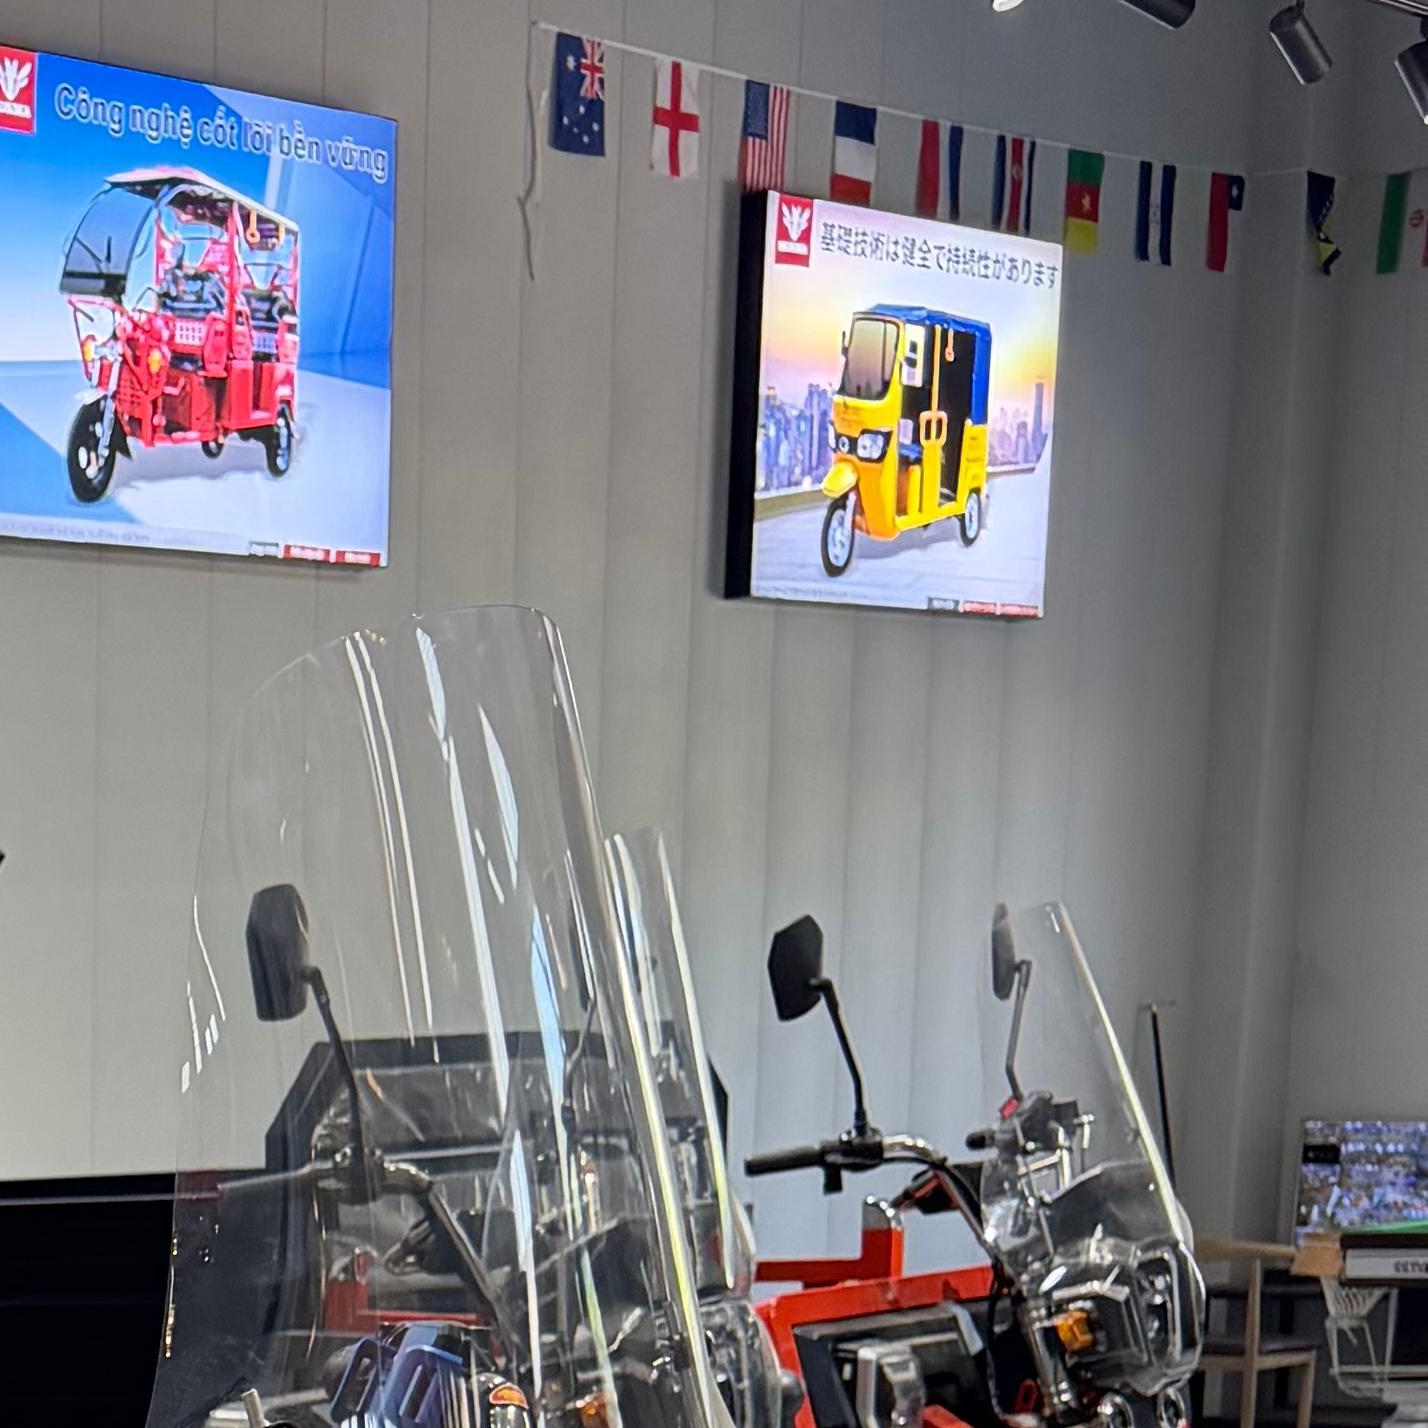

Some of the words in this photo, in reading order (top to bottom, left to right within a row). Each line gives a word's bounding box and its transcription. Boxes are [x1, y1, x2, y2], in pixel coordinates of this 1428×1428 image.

[55, 83, 125, 137] Công
[129, 101, 193, 149] nghệ
[197, 105, 238, 150] cốt
[277, 120, 322, 164] bền
[325, 136, 389, 184] vững
